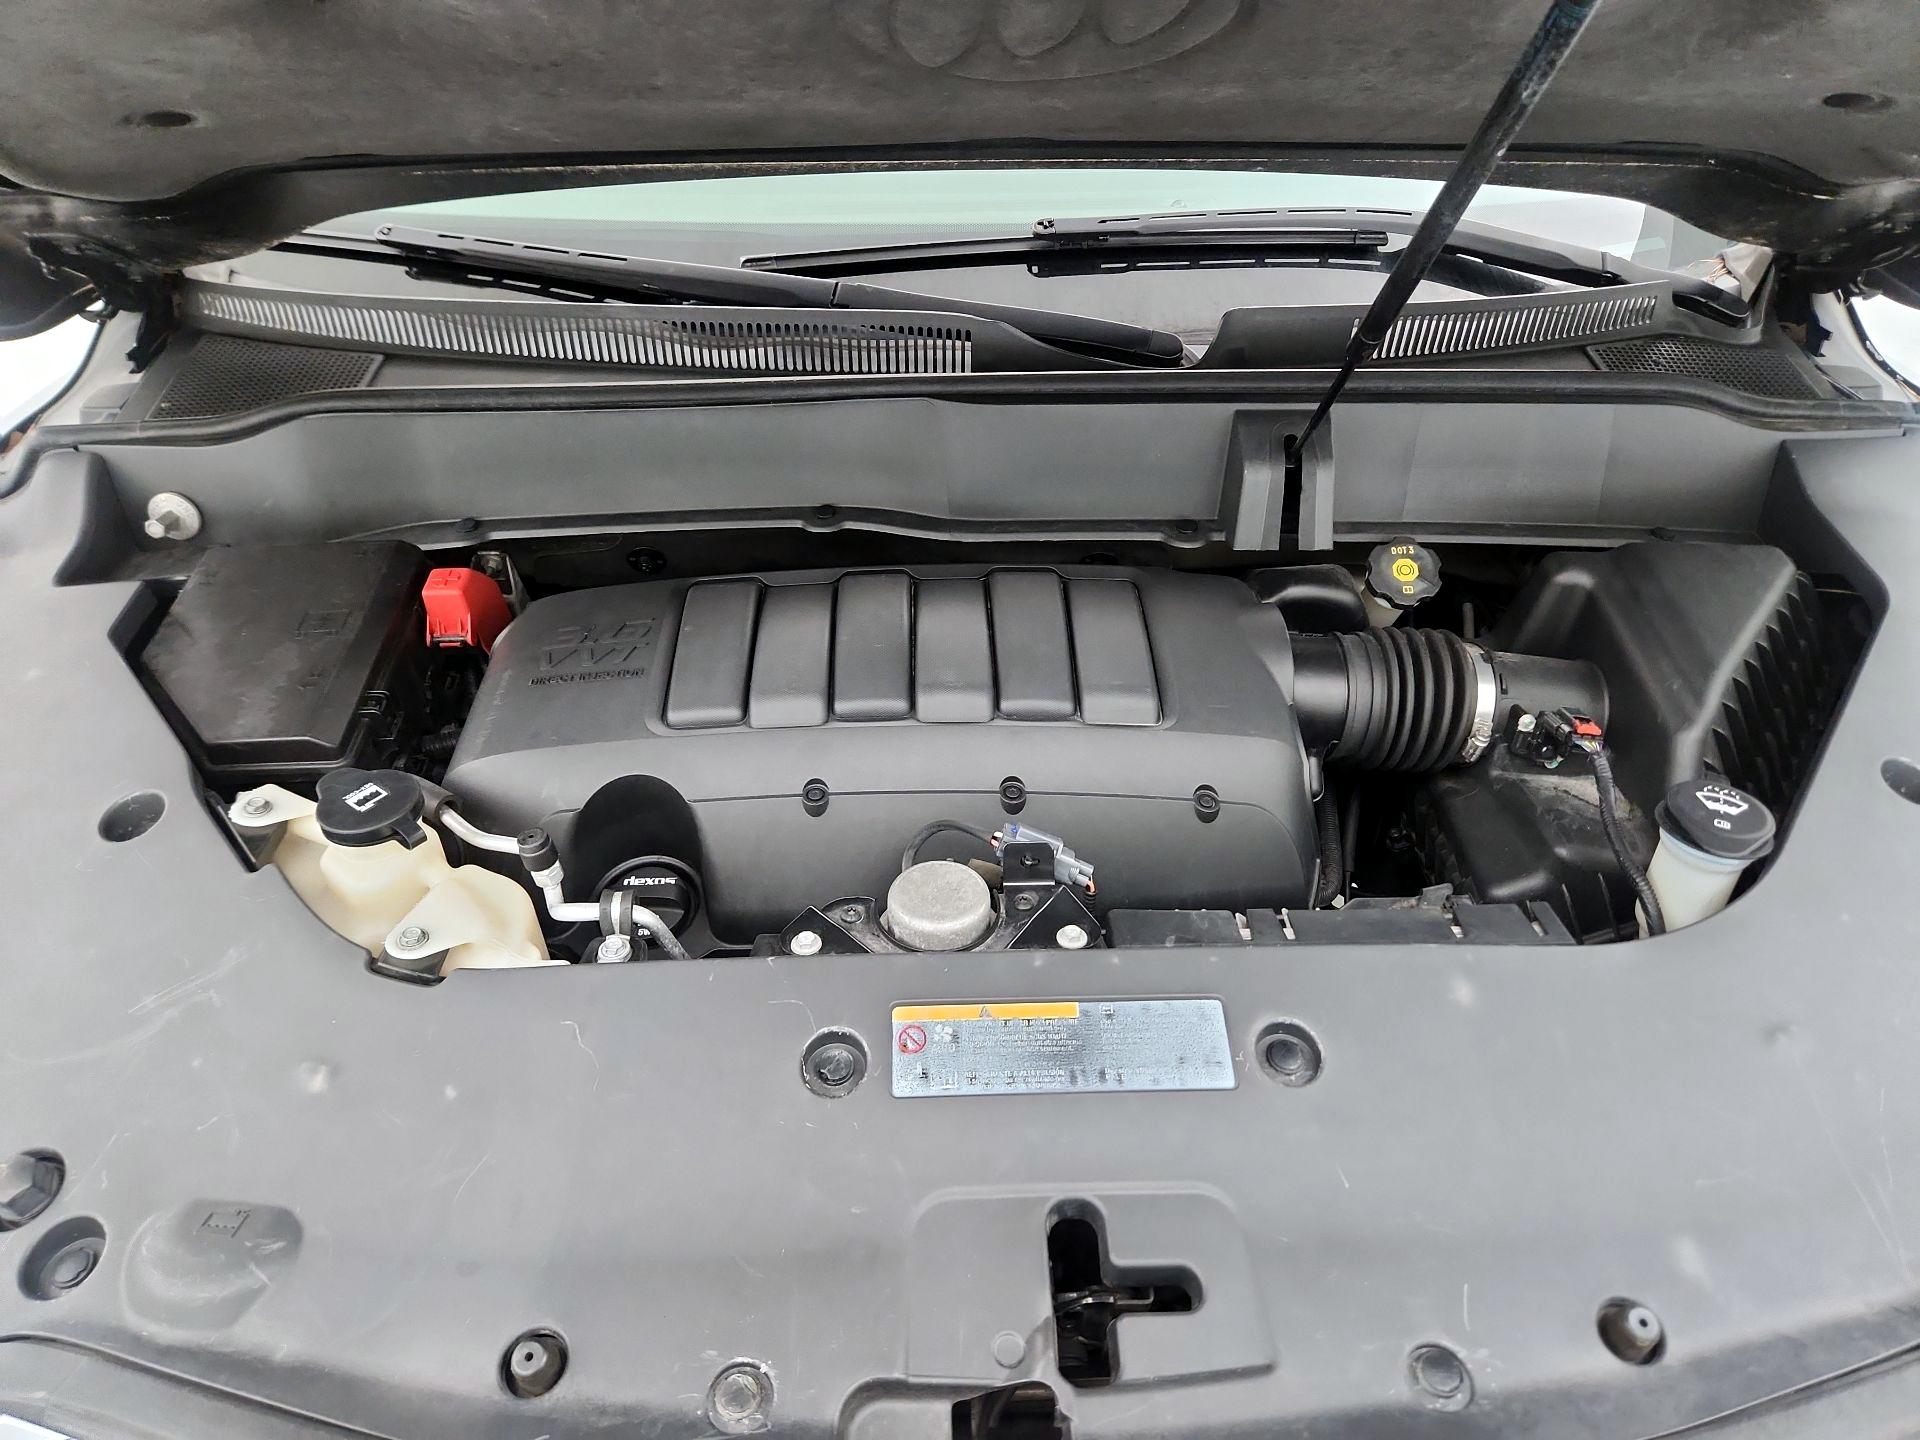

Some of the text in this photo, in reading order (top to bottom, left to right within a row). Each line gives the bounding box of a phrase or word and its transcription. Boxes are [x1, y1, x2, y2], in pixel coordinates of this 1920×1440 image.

[1390, 545, 1415, 555] DOT 3
[622, 875, 678, 886] dexos
